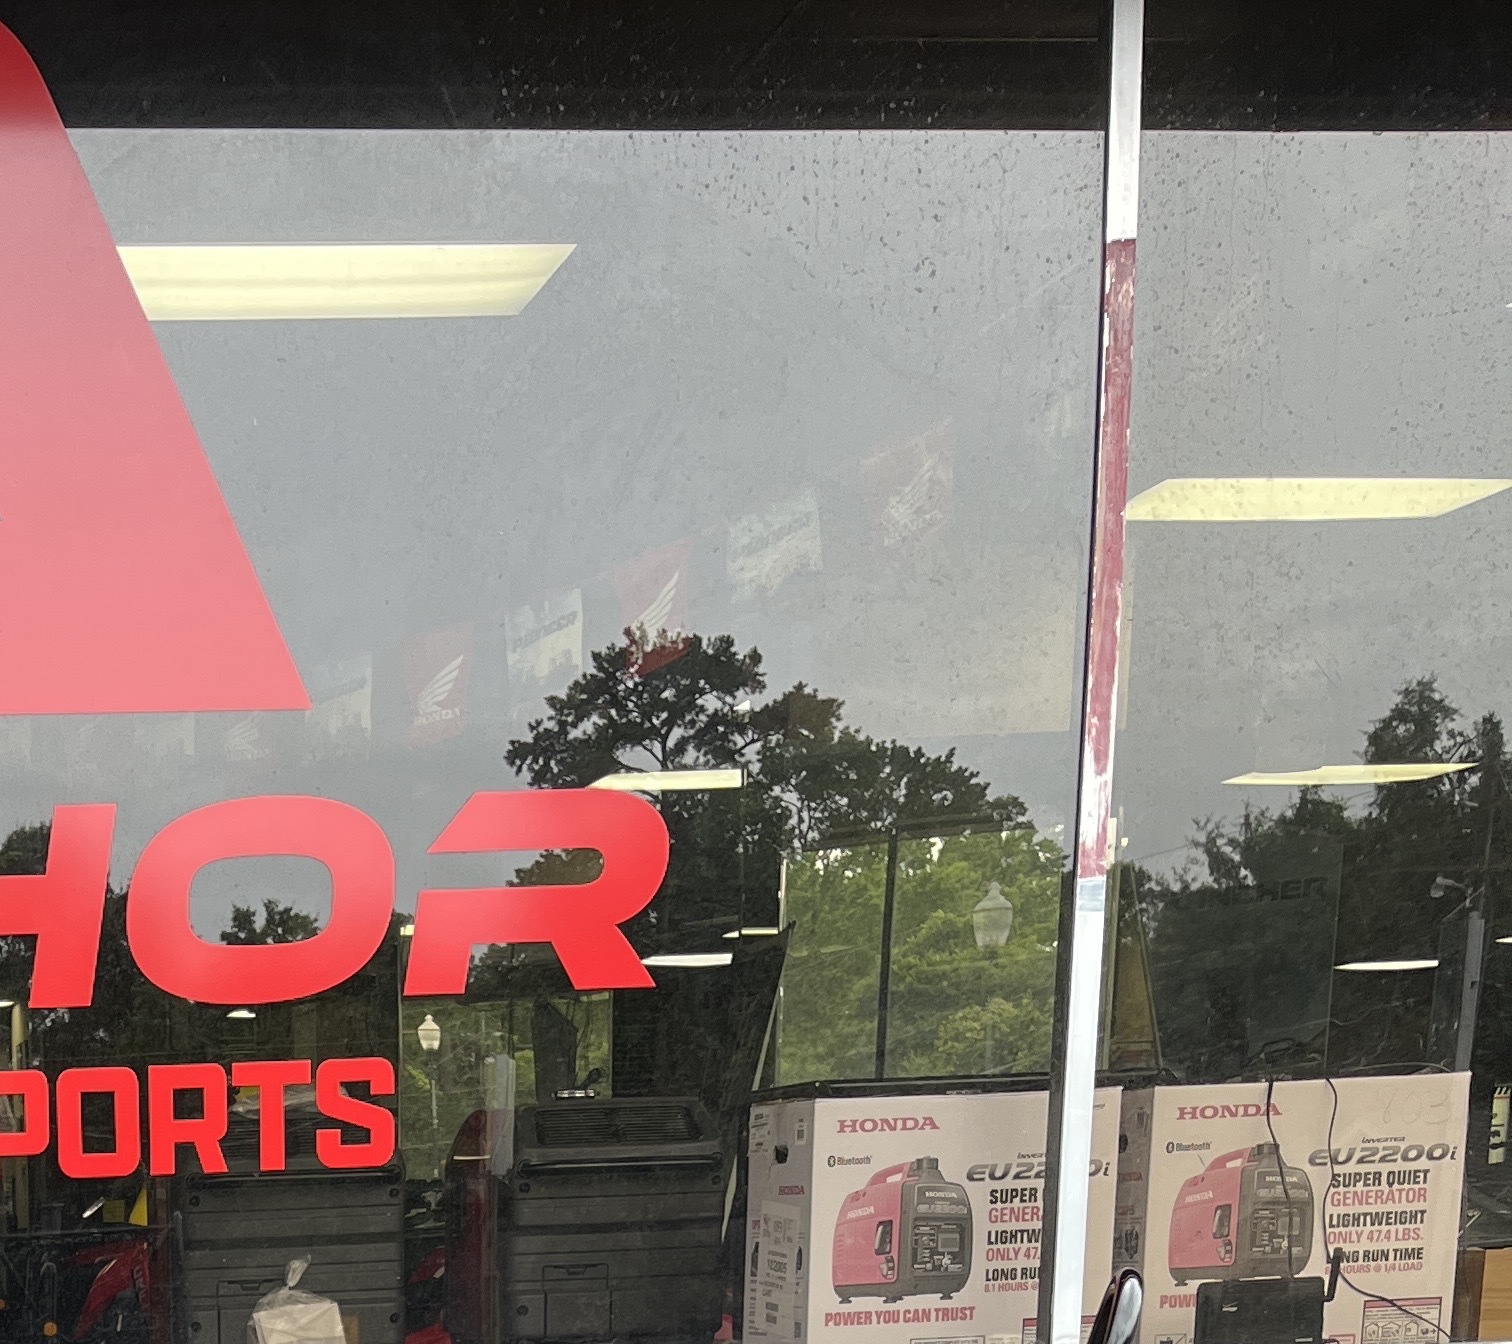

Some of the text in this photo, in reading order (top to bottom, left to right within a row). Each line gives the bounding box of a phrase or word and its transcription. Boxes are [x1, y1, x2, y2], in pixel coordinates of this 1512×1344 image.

[1176, 1103, 1282, 1120] HONDA
[837, 1117, 939, 1133] HONDA
[837, 1155, 873, 1166] Bluetooth
[1331, 1169, 1430, 1189] SUPER QUIET
[989, 1188, 1038, 1205] SUPER
[1330, 1187, 1428, 1208] GENERATOR
[988, 1207, 1043, 1224] GENER
[1328, 1209, 1427, 1229] LIGHTWEIGHT
[987, 1228, 1041, 1246] LIGHTW
[1327, 1227, 1423, 1245] ONLY 47.4 LBS.
[986, 1246, 1041, 1262] ONLY 47.
[1362, 1248, 1391, 1263] RUN
[1392, 1247, 1423, 1262] TIME
[985, 1267, 1017, 1283] LONG
[1398, 1261, 1423, 1272] LOAD
[998, 1282, 1028, 1292] HOURS
[824, 1306, 976, 1327] POWER YOU CAN TRUST
